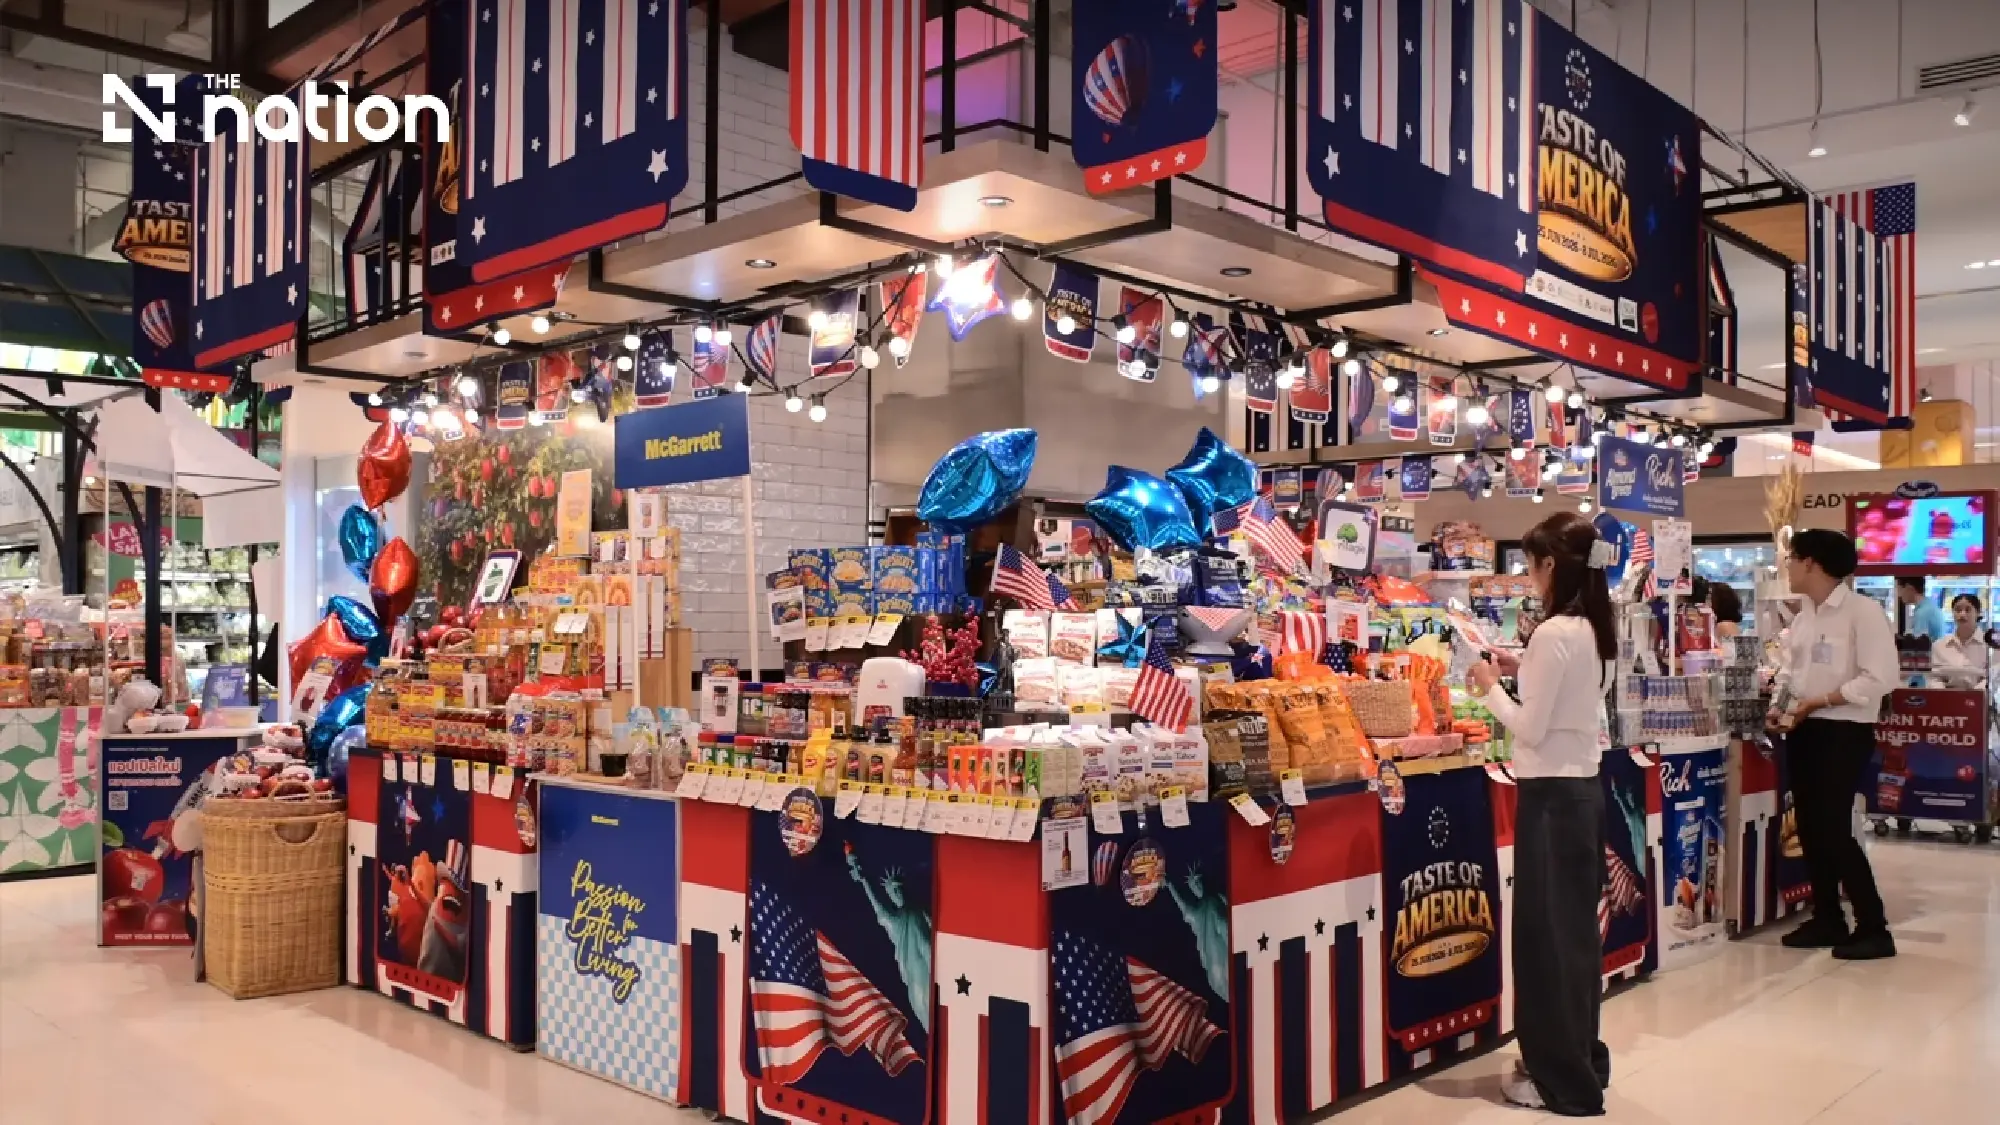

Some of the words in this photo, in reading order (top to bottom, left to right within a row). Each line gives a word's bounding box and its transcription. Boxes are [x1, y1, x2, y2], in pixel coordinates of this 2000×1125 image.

[1600, 139, 1626, 187] OF
[132, 199, 192, 217] TAST
[1538, 145, 1637, 262] MERICA
[119, 218, 192, 246] AME
[645, 430, 723, 460] McGarrett
[1803, 493, 1846, 509] EAD
[1874, 729, 1920, 743] AISED
[1926, 732, 1976, 746] BOLD
[1917, 715, 1968, 728] TART
[1660, 759, 1691, 797] Rich
[571, 860, 645, 913] Passion
[1402, 861, 1455, 901] TASTE
[1459, 861, 1482, 887] OF
[568, 898, 628, 953] Better
[1394, 888, 1494, 957] AMERICA
[576, 934, 638, 999] Living
